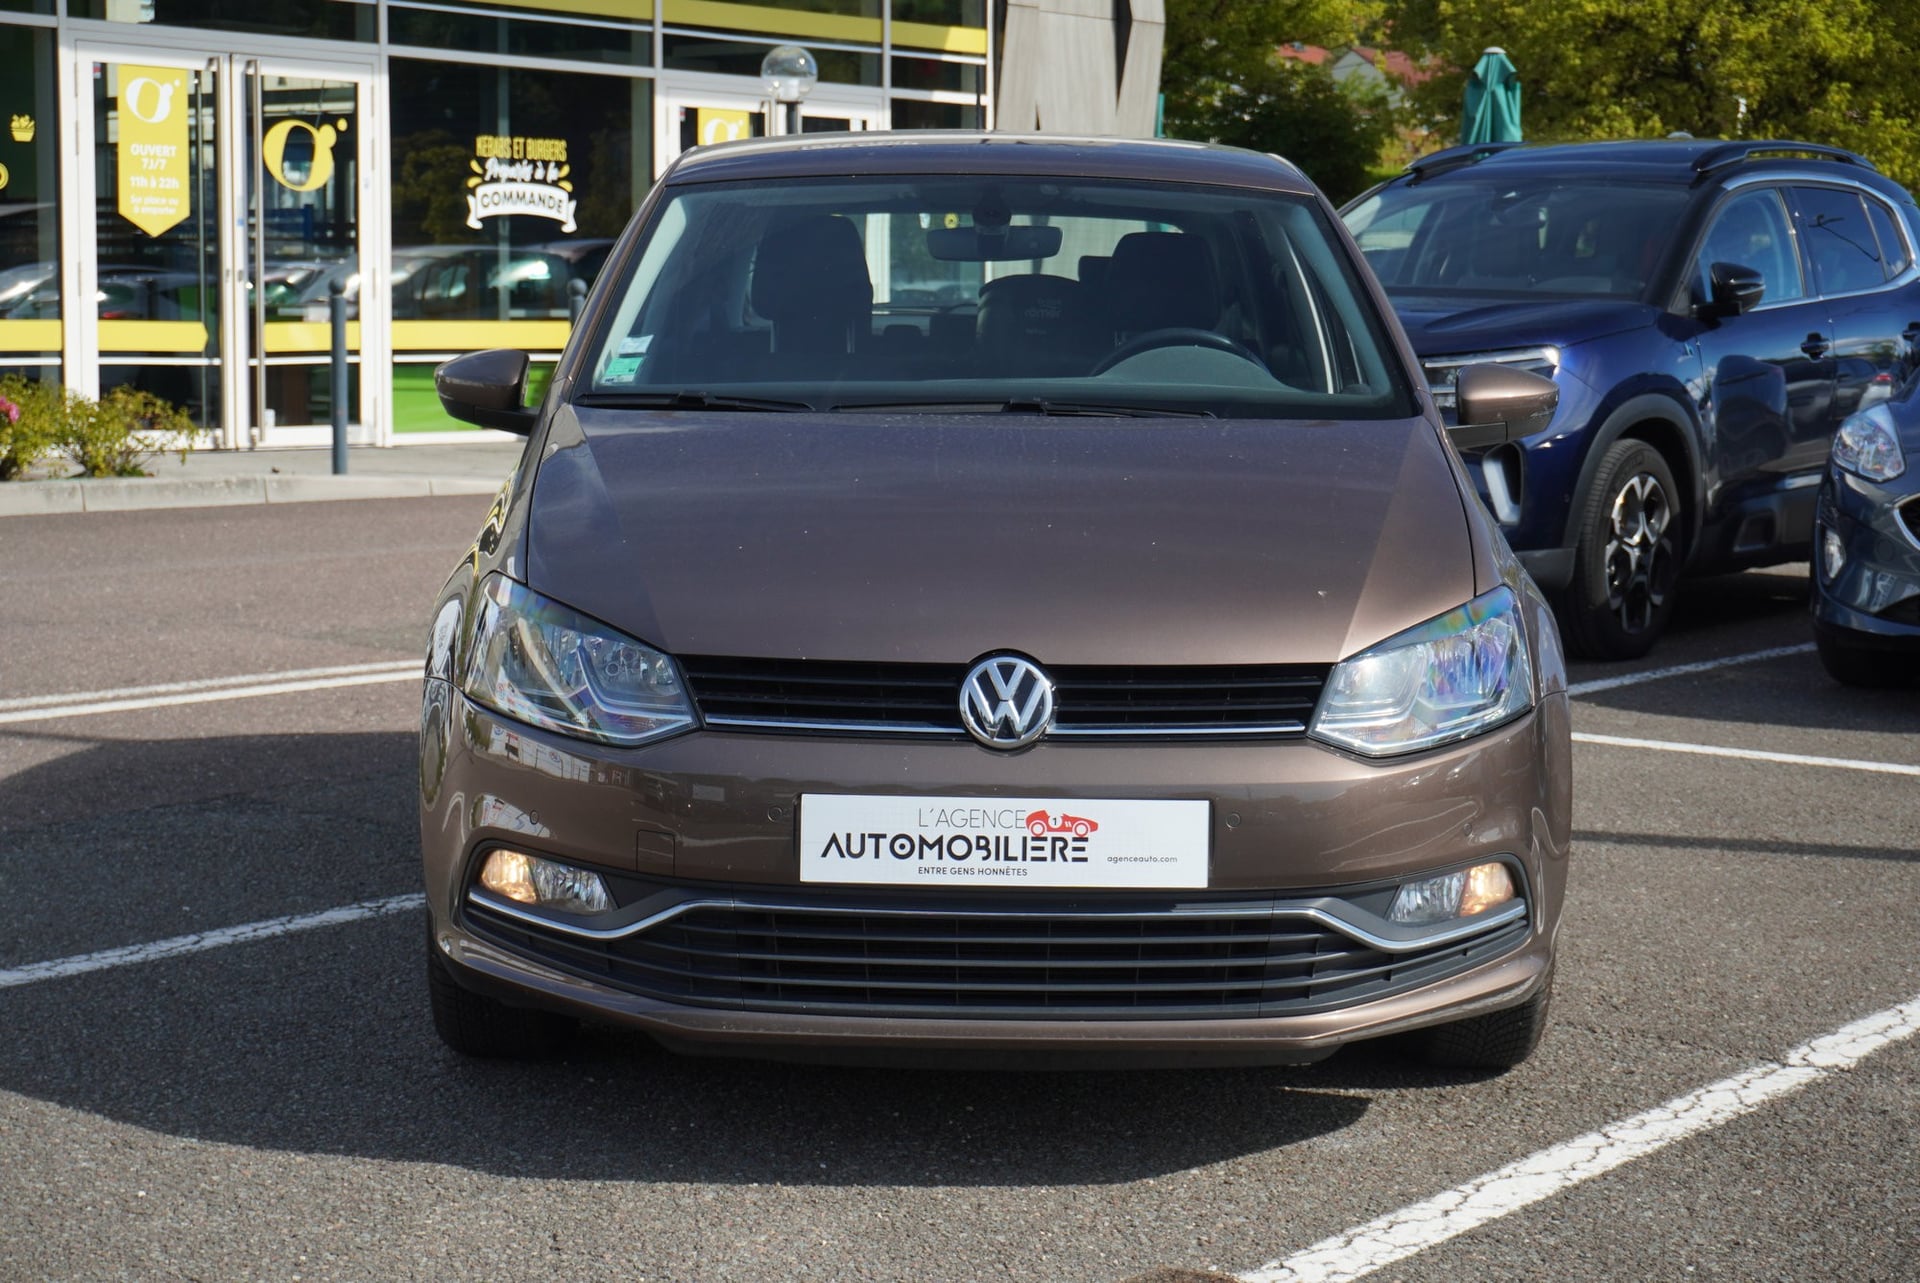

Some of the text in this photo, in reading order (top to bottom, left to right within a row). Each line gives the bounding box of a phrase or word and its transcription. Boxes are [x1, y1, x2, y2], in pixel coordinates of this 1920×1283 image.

[130, 143, 177, 157] OUVERT
[476, 136, 567, 162] KEBABS ET BURGERS
[150, 176, 157, 189] à
[158, 177, 181, 190] 22h
[481, 192, 563, 213] COMMANDE
[918, 807, 1026, 829] L'AGENCE
[1106, 855, 1178, 865] agenceauto.com
[918, 865, 1028, 877] ENTRE GENS HONNÊTES
